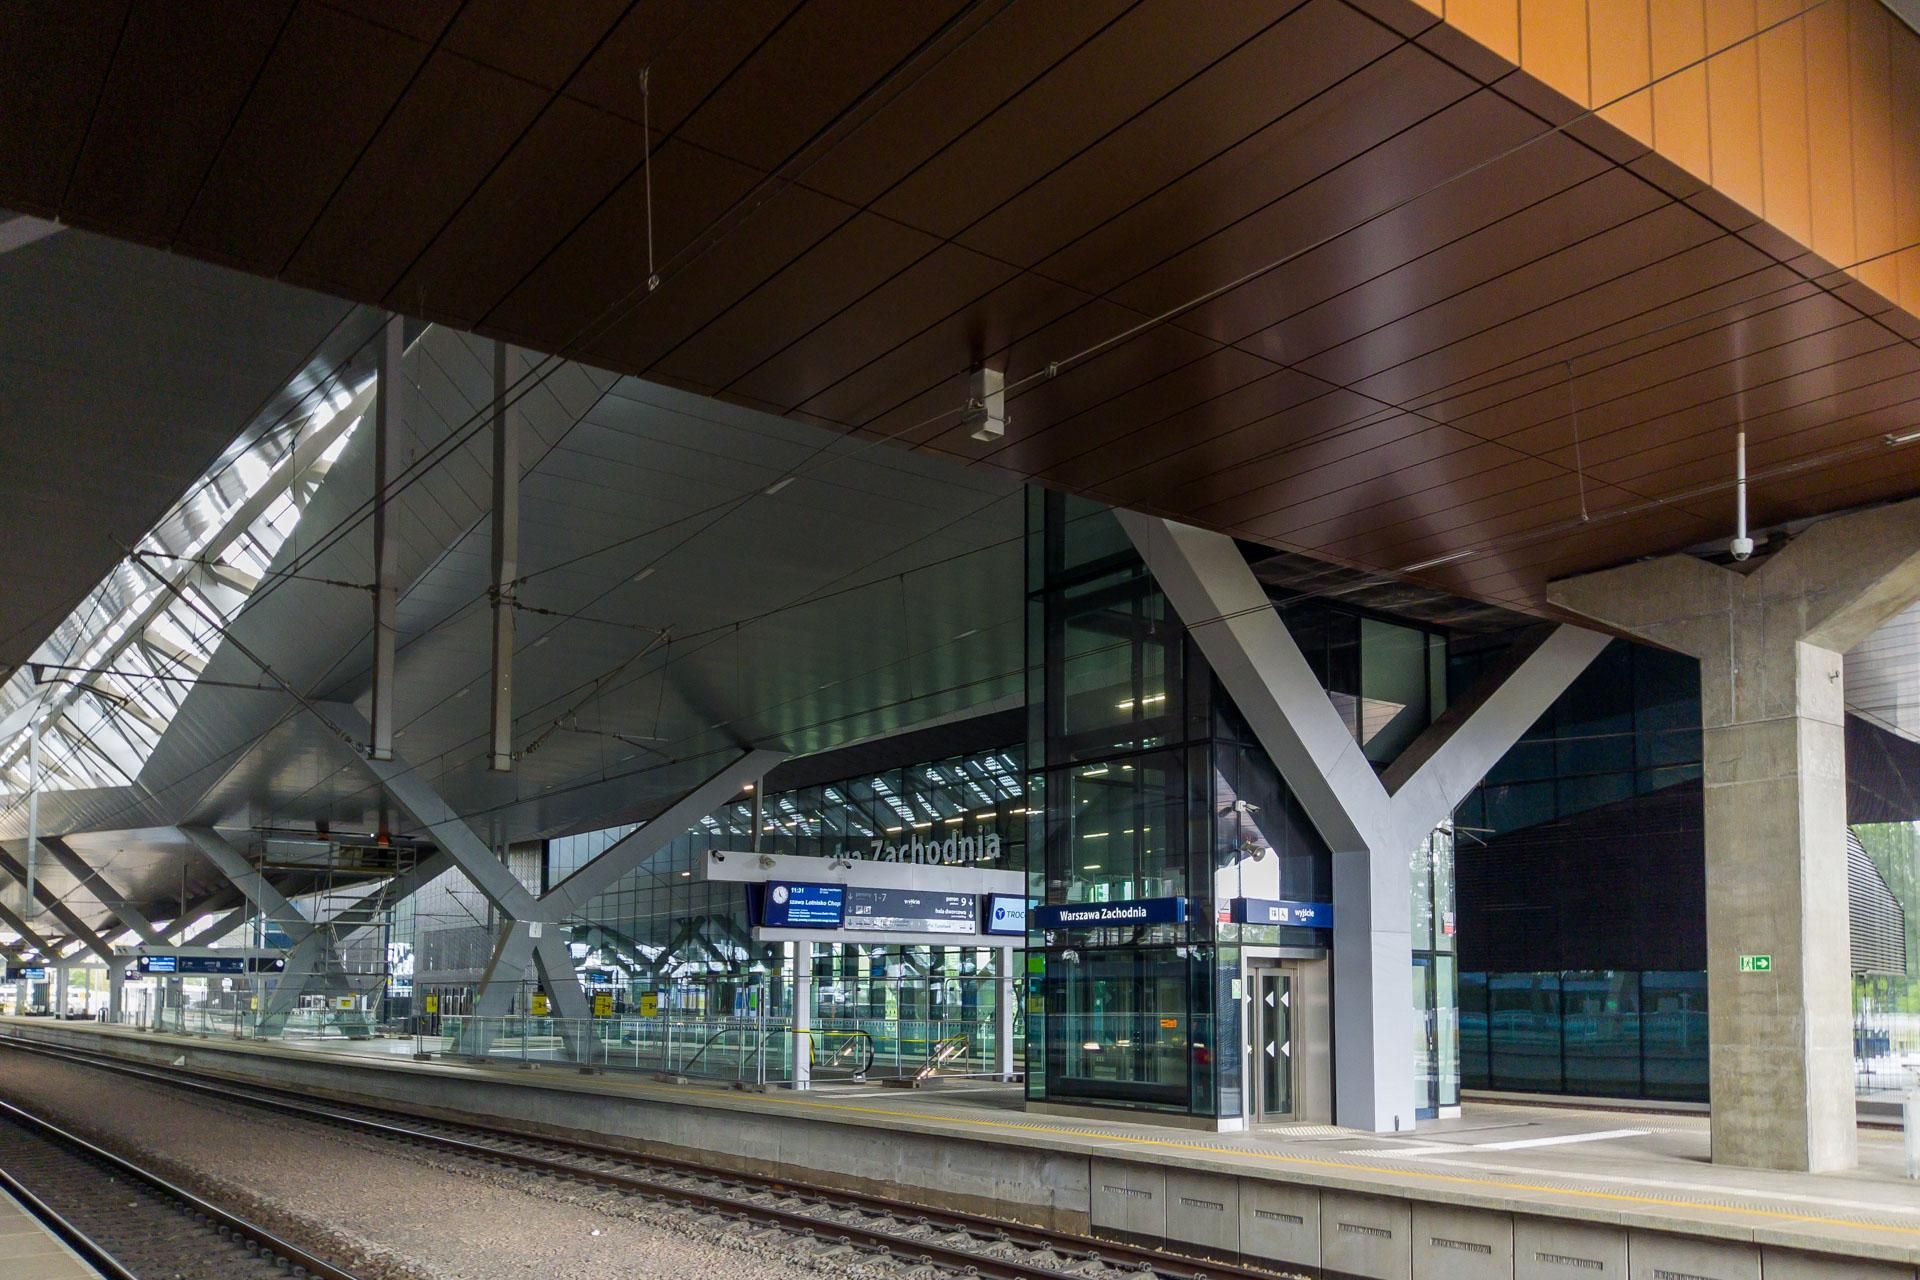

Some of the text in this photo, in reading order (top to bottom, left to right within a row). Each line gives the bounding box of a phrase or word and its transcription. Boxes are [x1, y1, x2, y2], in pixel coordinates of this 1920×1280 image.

[870, 824, 1001, 866] Zachodnia
[960, 897, 967, 906] 9
[1059, 906, 1147, 921] Warszawa Zachodnia
